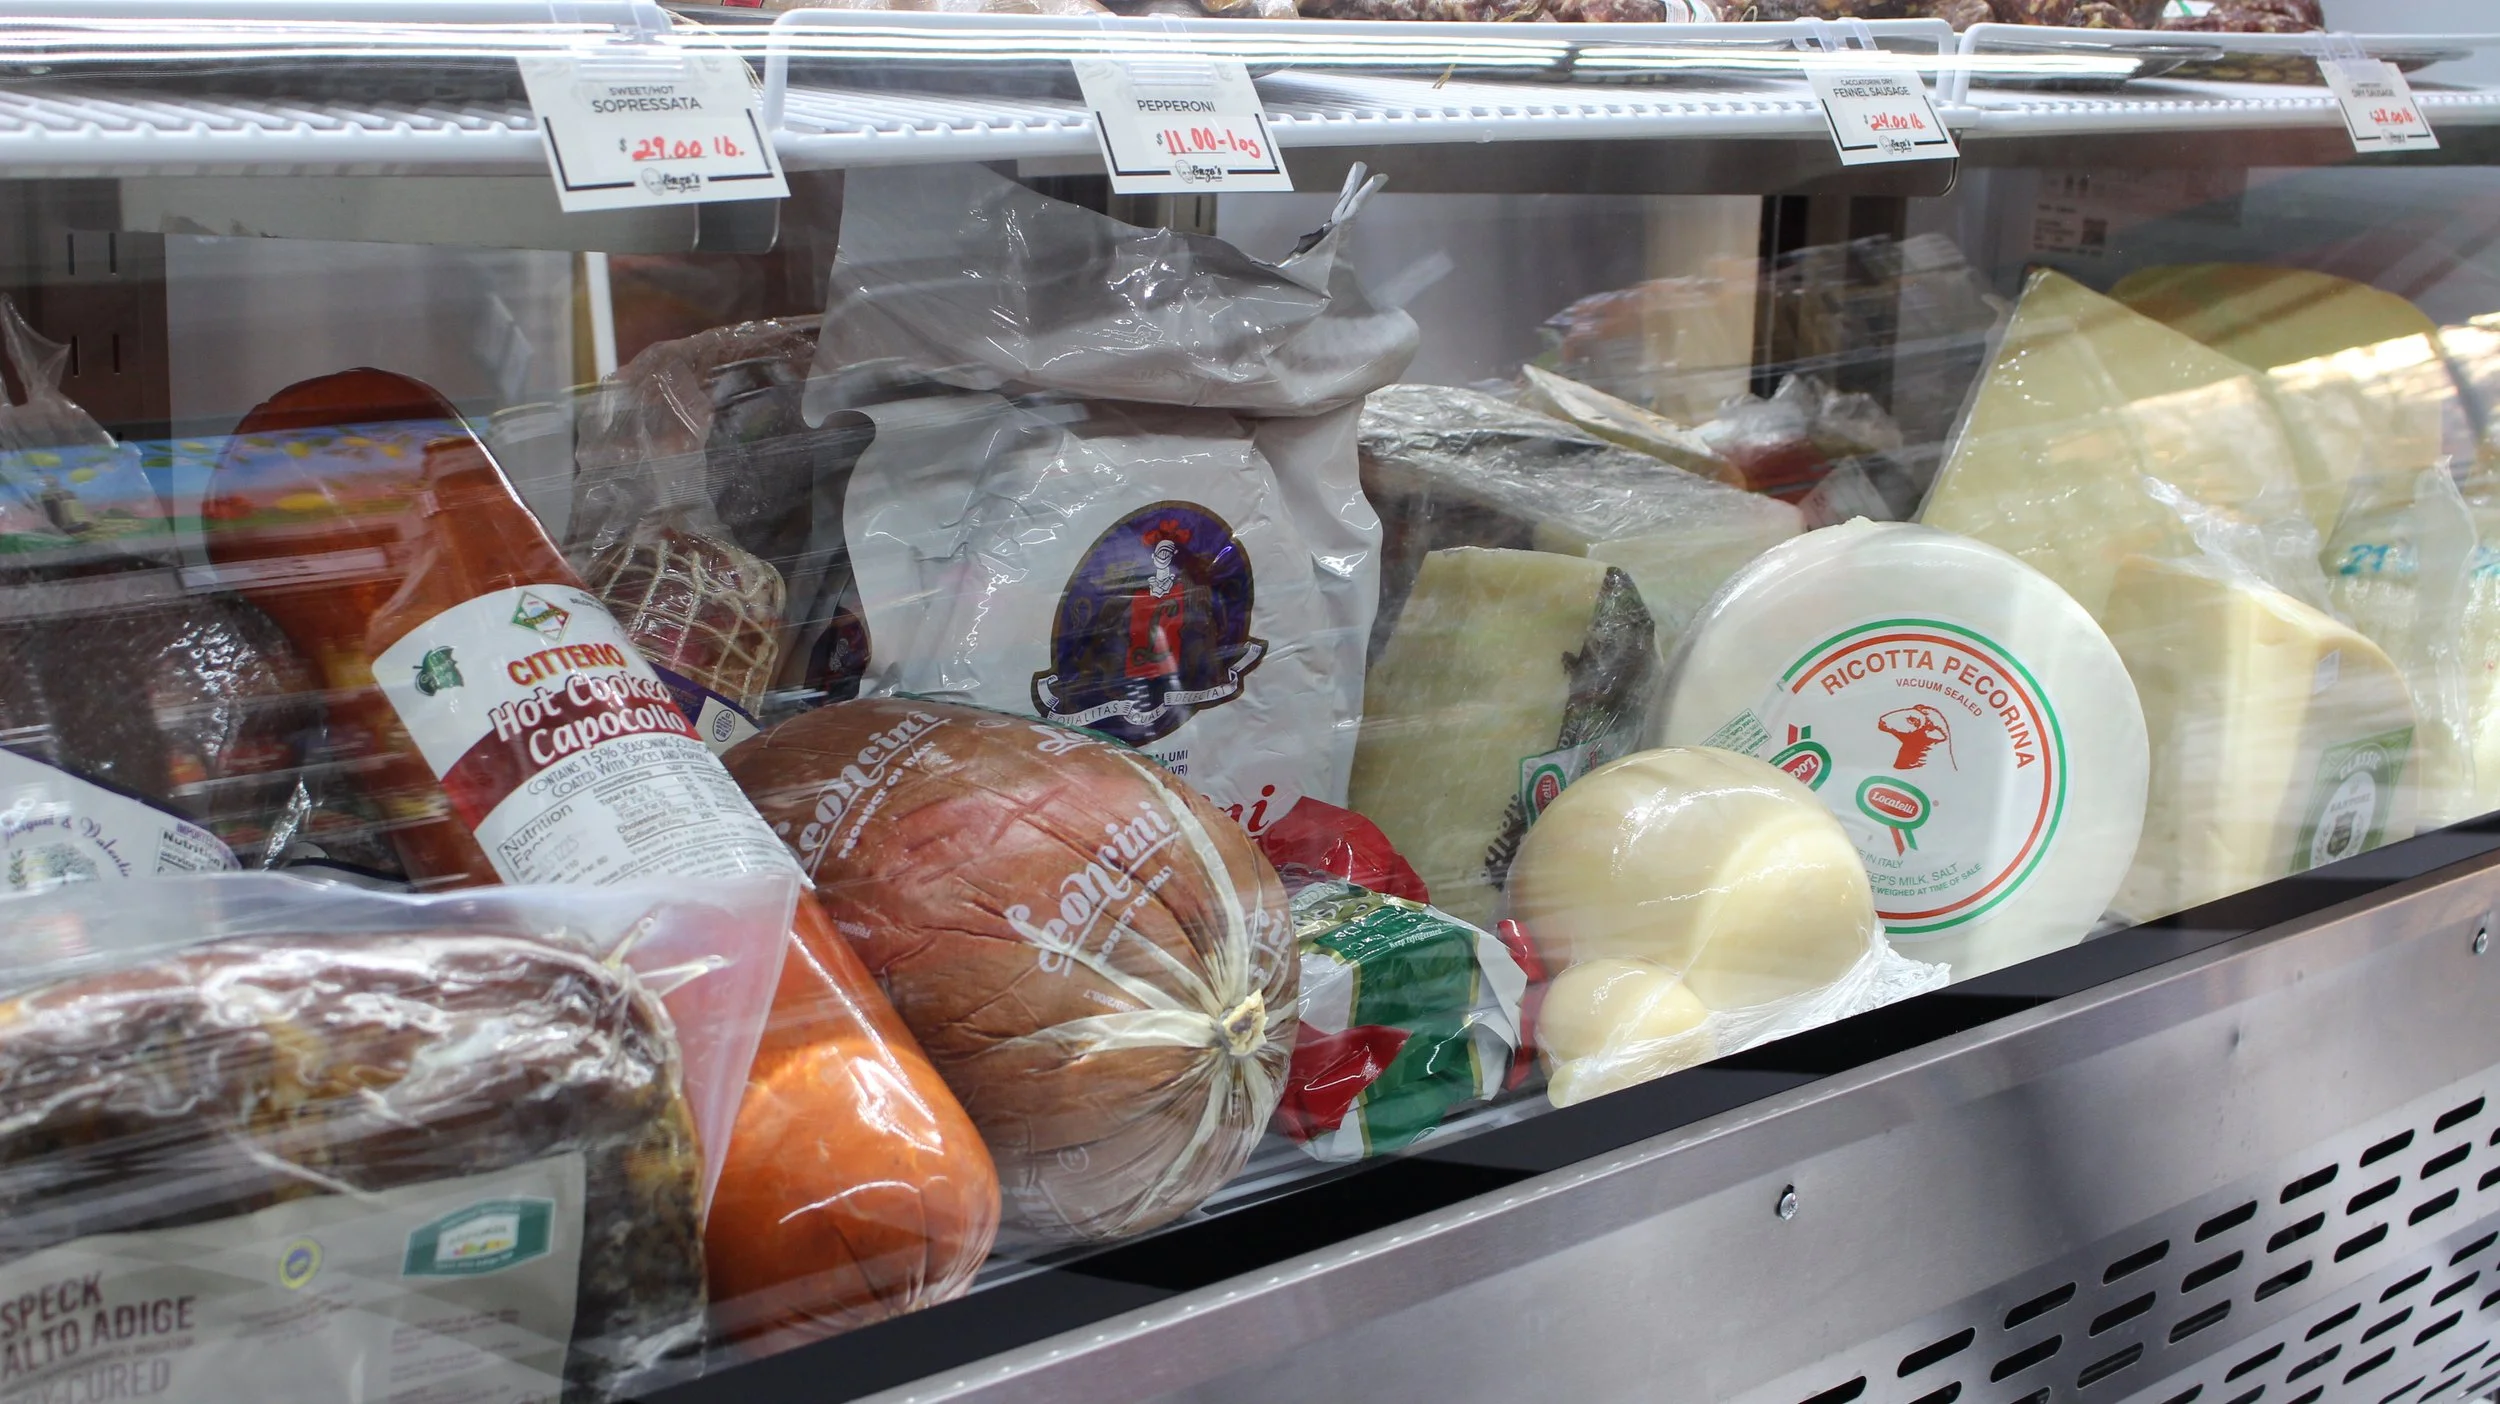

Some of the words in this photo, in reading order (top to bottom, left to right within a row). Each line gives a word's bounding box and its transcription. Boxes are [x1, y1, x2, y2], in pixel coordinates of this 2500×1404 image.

[592, 97, 702, 114] SOPRESSATA
[609, 85, 675, 96] SWEET/HOT
[1137, 99, 1216, 113] PEPPERONI
[1833, 88, 1870, 98] FENNEL
[1869, 86, 1911, 97] SAUSAGE
[507, 643, 627, 686] CITTERIO
[489, 686, 562, 742] Hot
[565, 670, 671, 708] Cooked
[1056, 701, 1119, 726] QUALITAS
[1130, 708, 1163, 726] QUAE
[1174, 685, 1227, 703] DELECTAT
[1820, 649, 1934, 696] RICOTTA
[1942, 655, 2036, 770] PECORINA
[1895, 677, 1943, 693] VACUUM
[1943, 686, 1983, 718] SEALED
[528, 702, 688, 766] Capocollo
[527, 761, 581, 796] CONTAINS
[581, 746, 618, 767] 15%
[1155, 749, 1189, 763] ALUMI
[551, 770, 597, 798] COATED
[594, 758, 630, 776] WITH
[1871, 791, 1915, 815] Locatelli
[504, 804, 574, 857] Nutrition
[1865, 853, 1877, 864] IN
[1878, 857, 1904, 869] ITALY
[1866, 870, 1896, 886] EEP'S
[1931, 863, 1959, 881] SALT
[1877, 887, 1915, 896] WEIGHED
[1917, 887, 1928, 895] AT
[1929, 881, 1949, 893] TIME
[1949, 876, 1961, 886] OF
[1961, 863, 1982, 881] SALE
[1003, 801, 1171, 974] Leoncini
[1388, 937, 1405, 949] Keep
[0, 1272, 103, 1340] SPECK
[0, 1318, 81, 1384] ALTO
[92, 1294, 197, 1346] ADIGE
